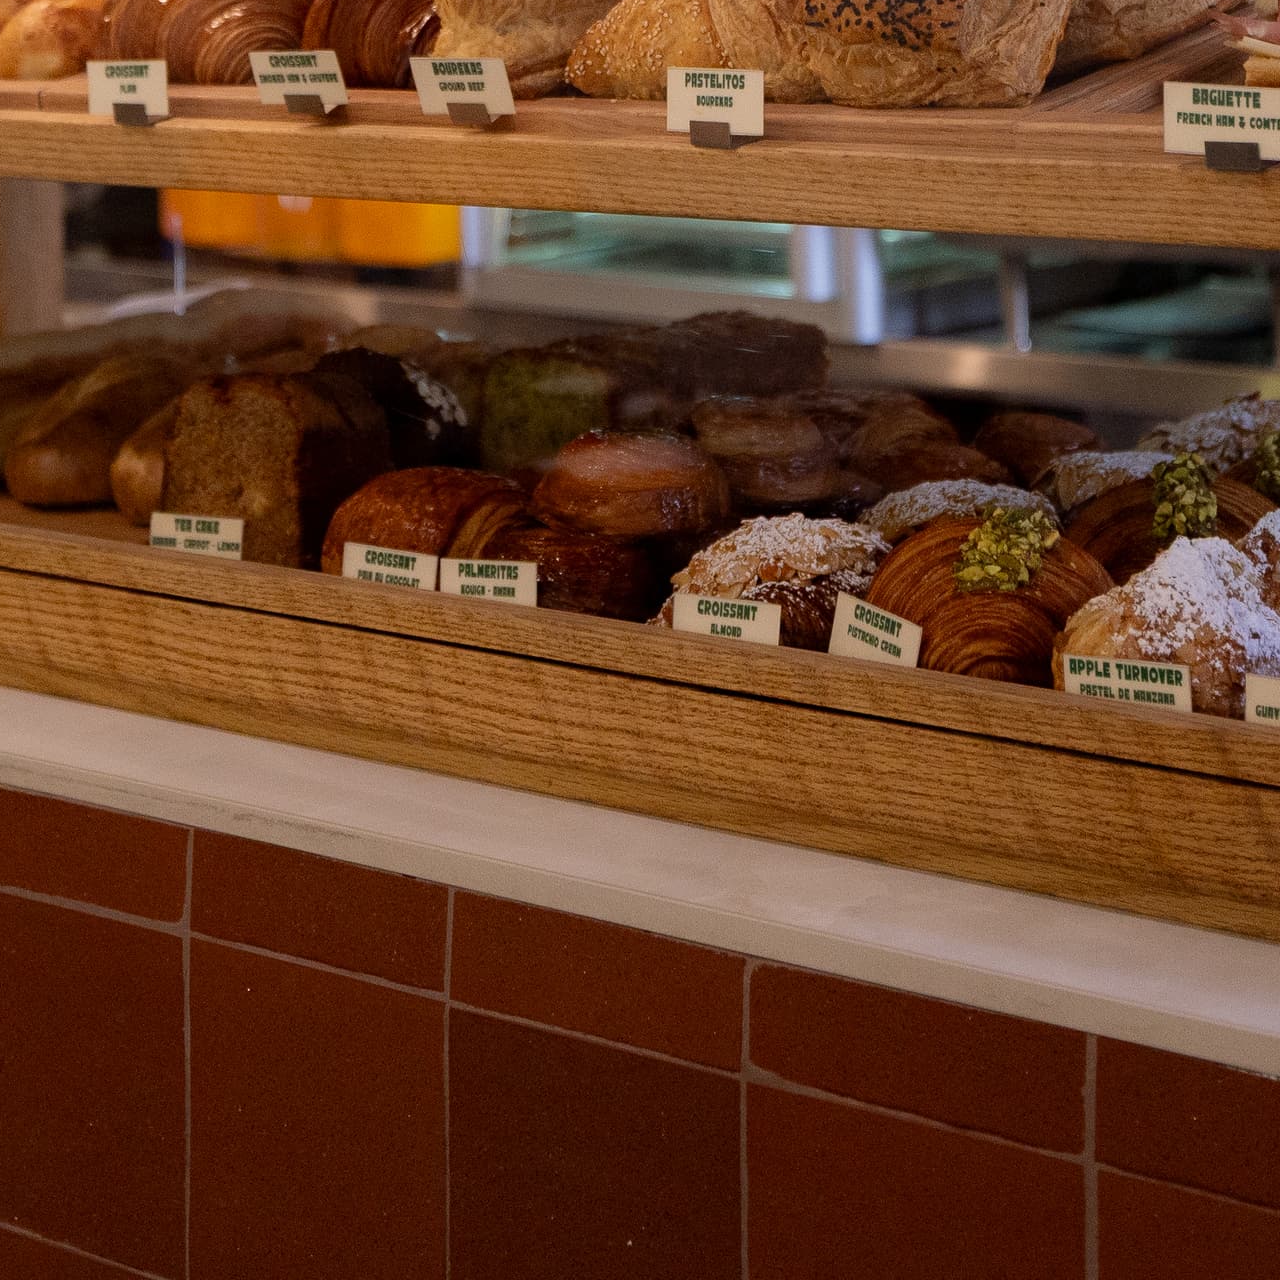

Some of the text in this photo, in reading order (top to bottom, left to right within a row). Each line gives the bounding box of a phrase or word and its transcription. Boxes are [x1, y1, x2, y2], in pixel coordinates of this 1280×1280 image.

[269, 55, 318, 68] CROISSANT
[432, 61, 484, 77] BOUREKAS
[439, 81, 485, 92] GROUND BEEF
[685, 72, 746, 90] PASTELITOS
[696, 95, 733, 108] BOUREKAS
[1192, 88, 1261, 109] BAGUETTE
[1176, 111, 1213, 126] FRENCH
[1216, 114, 1235, 128] HAM
[1238, 116, 1247, 128] &
[365, 550, 417, 571] CROISSANT
[458, 563, 519, 581] PALMERITAS
[697, 599, 758, 622] CROISSANT
[854, 604, 903, 638] CROISSANT
[710, 623, 742, 638] ALMOND
[847, 624, 902, 659] PISTACHIO CREAM
[1068, 658, 1184, 688] APPLE TURNOVER
[1079, 683, 1176, 706] PASTEL DE MANZANA
